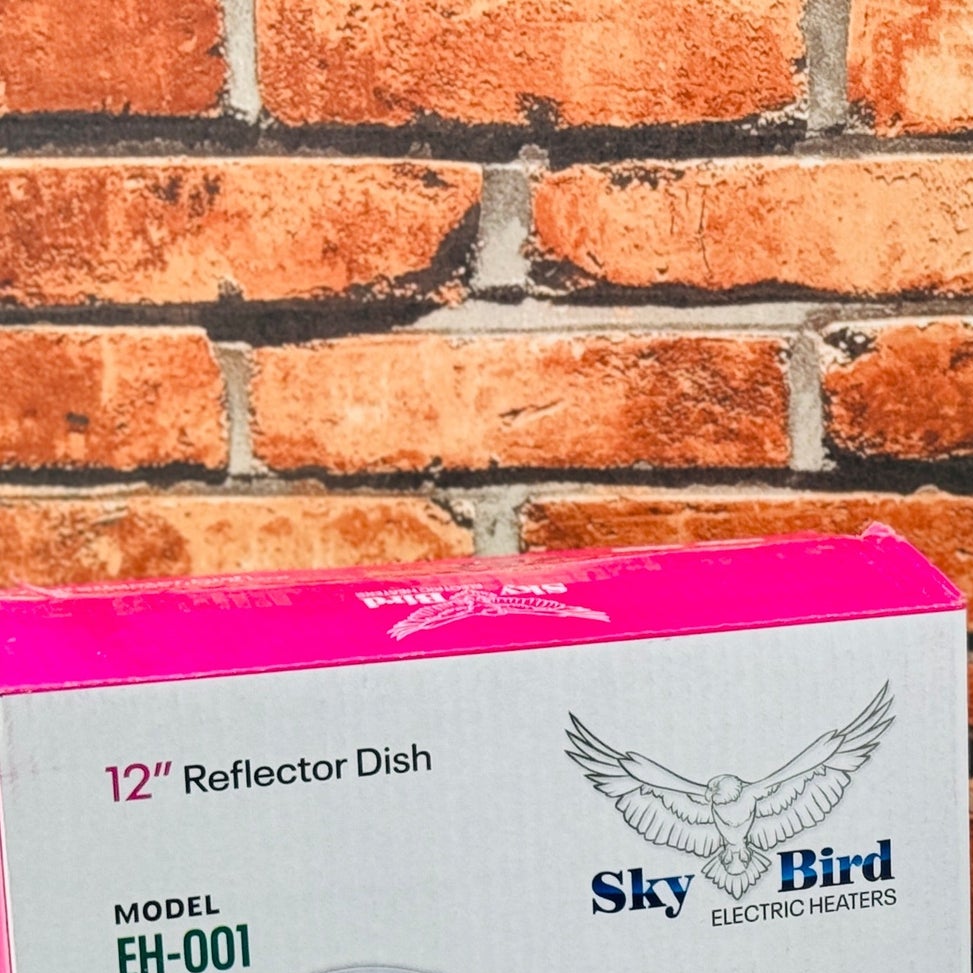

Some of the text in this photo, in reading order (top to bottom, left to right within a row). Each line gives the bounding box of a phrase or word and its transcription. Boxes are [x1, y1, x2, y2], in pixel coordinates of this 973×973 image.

[184, 758, 348, 794] Reflector
[356, 744, 432, 777] Dish
[591, 839, 895, 919] Sky Bird
[114, 895, 220, 925] MODEL
[711, 888, 897, 927] ELECTRIC HEATERS
